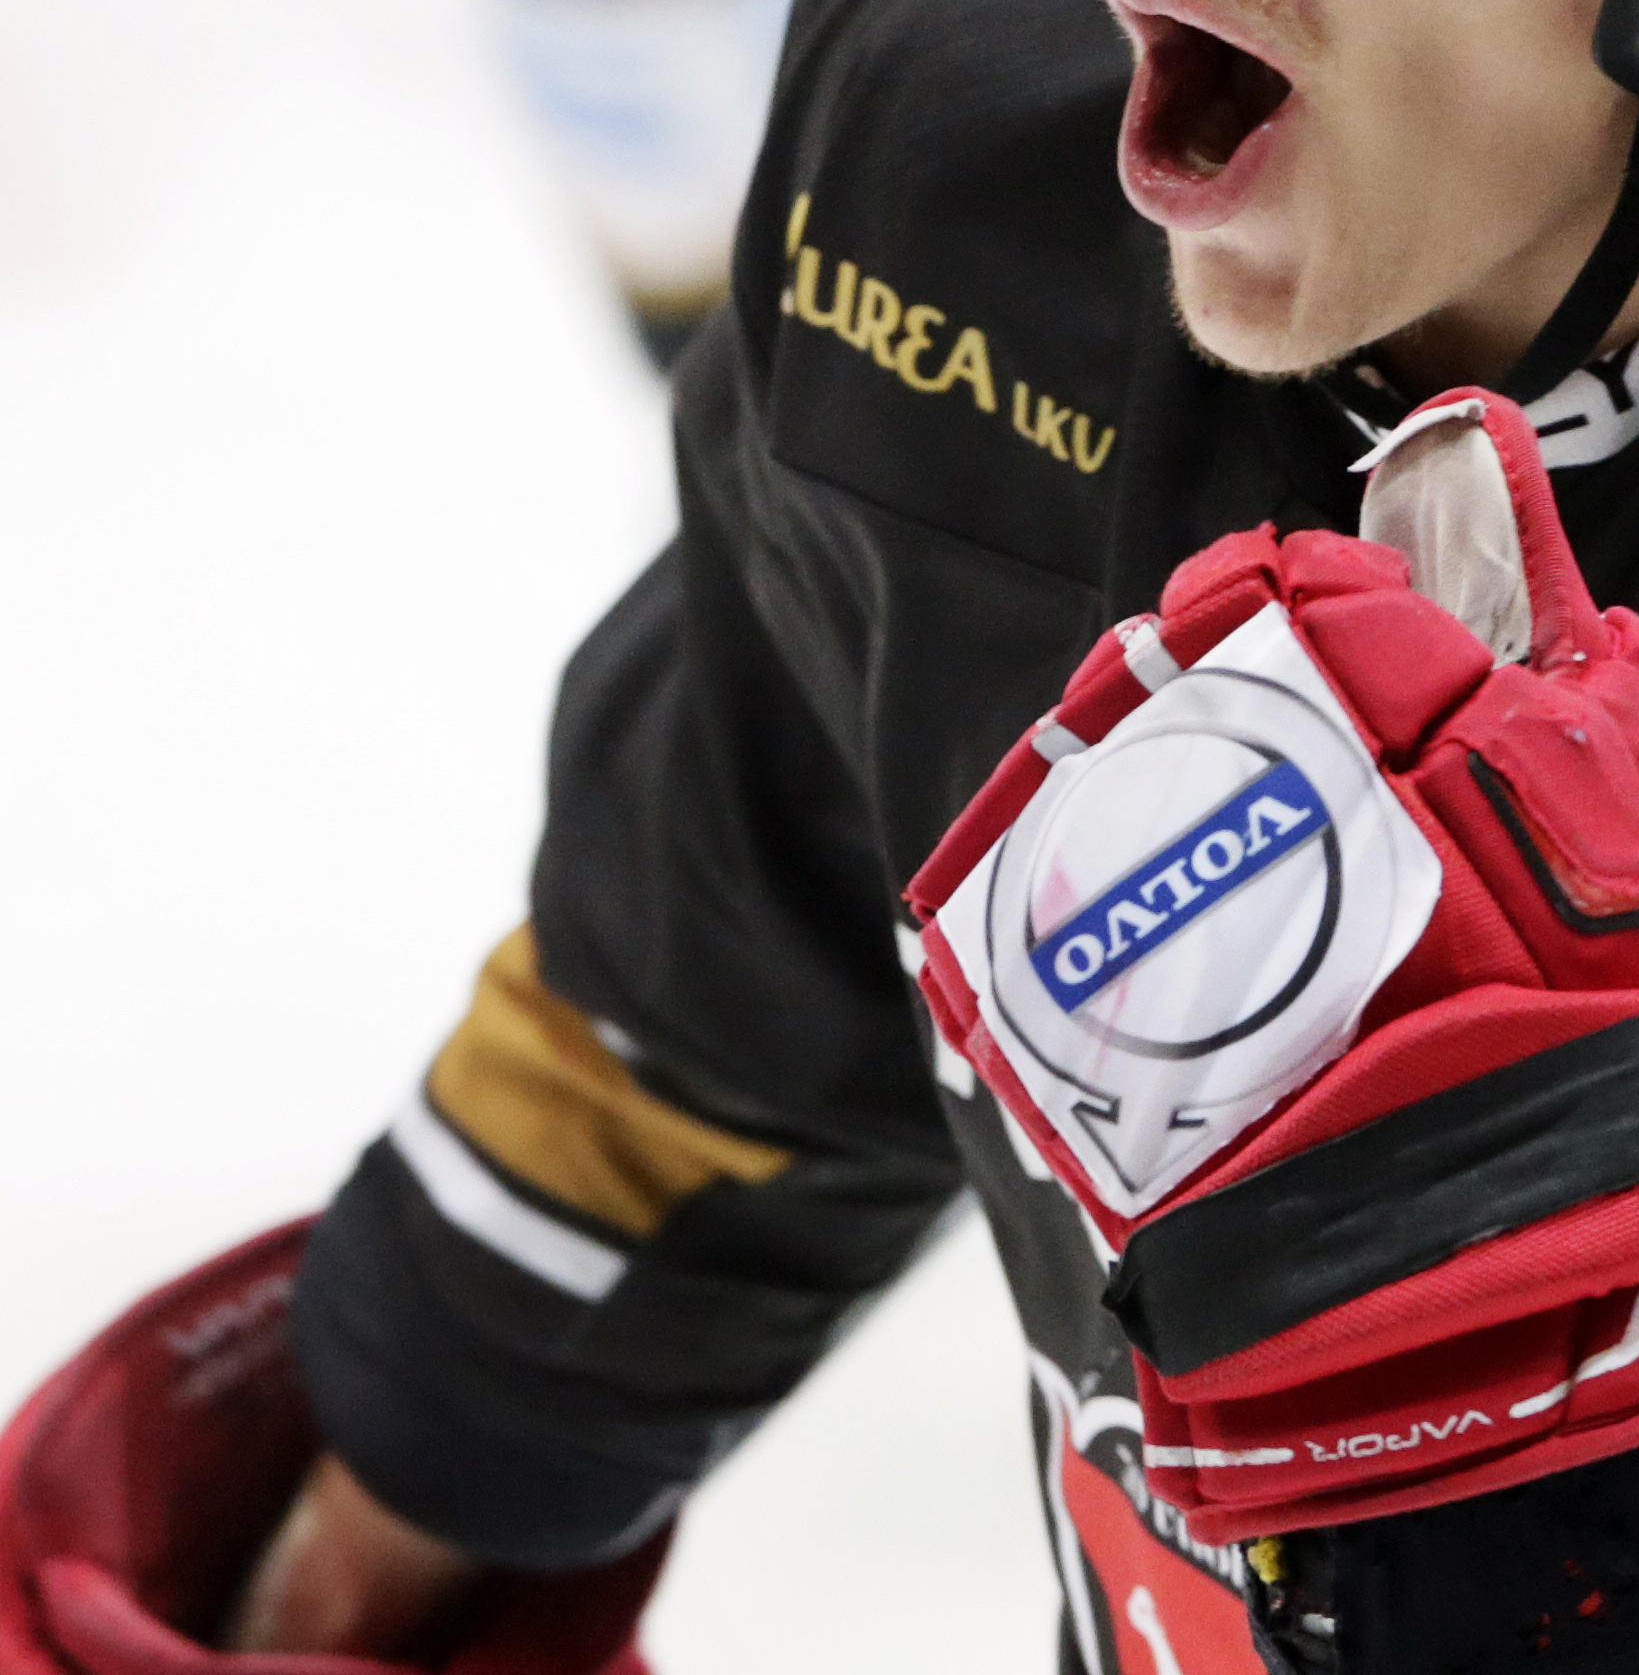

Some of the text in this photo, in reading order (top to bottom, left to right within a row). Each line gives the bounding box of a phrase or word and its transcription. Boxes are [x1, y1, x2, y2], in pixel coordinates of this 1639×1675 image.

[780, 191, 1116, 474] UREA LKV
[1053, 793, 1312, 986] VOLVO
[1303, 1409, 1494, 1463] VAPOR
